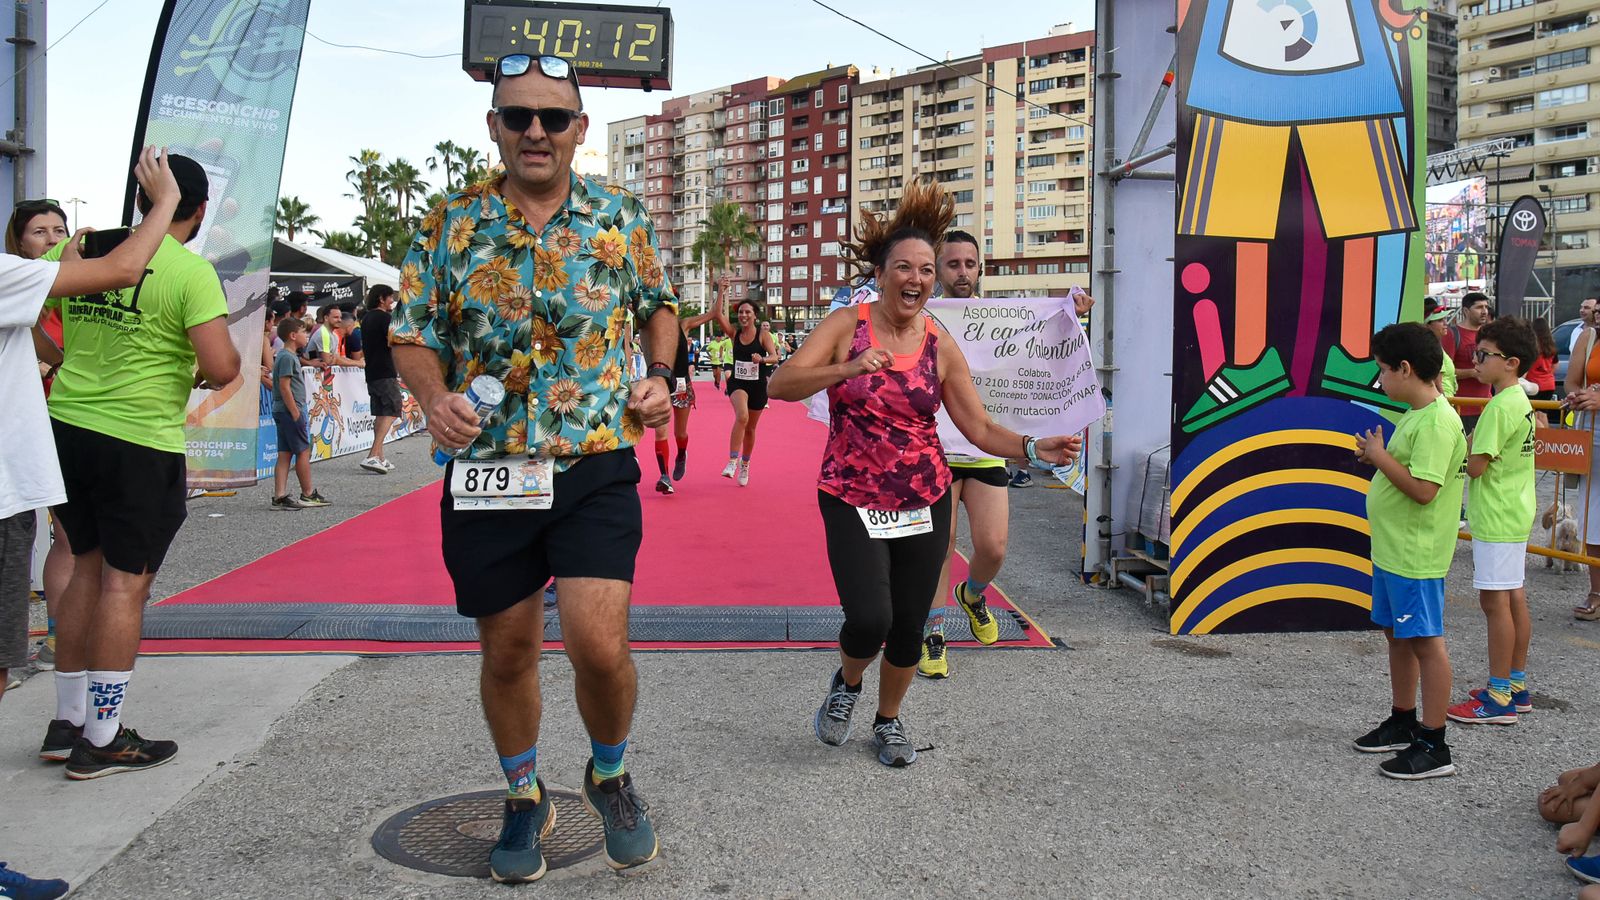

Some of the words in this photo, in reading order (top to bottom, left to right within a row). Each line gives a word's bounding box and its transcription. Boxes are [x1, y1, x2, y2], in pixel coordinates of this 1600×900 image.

[161, 93, 279, 120] #GESCONCHIP
[253, 120, 278, 132] VIVO
[1511, 237, 1537, 247] TOMAX
[963, 305, 1036, 320] Asociación
[963, 322, 985, 341] El
[994, 340, 1020, 359] de
[1026, 332, 1086, 360] Valentina
[736, 367, 748, 375] 180
[1018, 367, 1051, 378] Colabora
[985, 377, 1009, 388] 2100
[1012, 378, 1034, 389] 8508
[1037, 381, 1055, 390] 5102
[989, 389, 1028, 400] Concepto
[1013, 406, 1061, 417] mutacion
[1063, 383, 1098, 411] CNTNAP
[205, 449, 224, 458] 784
[1544, 442, 1585, 456] INNOVIA
[465, 466, 510, 492] 879
[867, 508, 899, 526] 880
[89, 680, 129, 694] JUST
